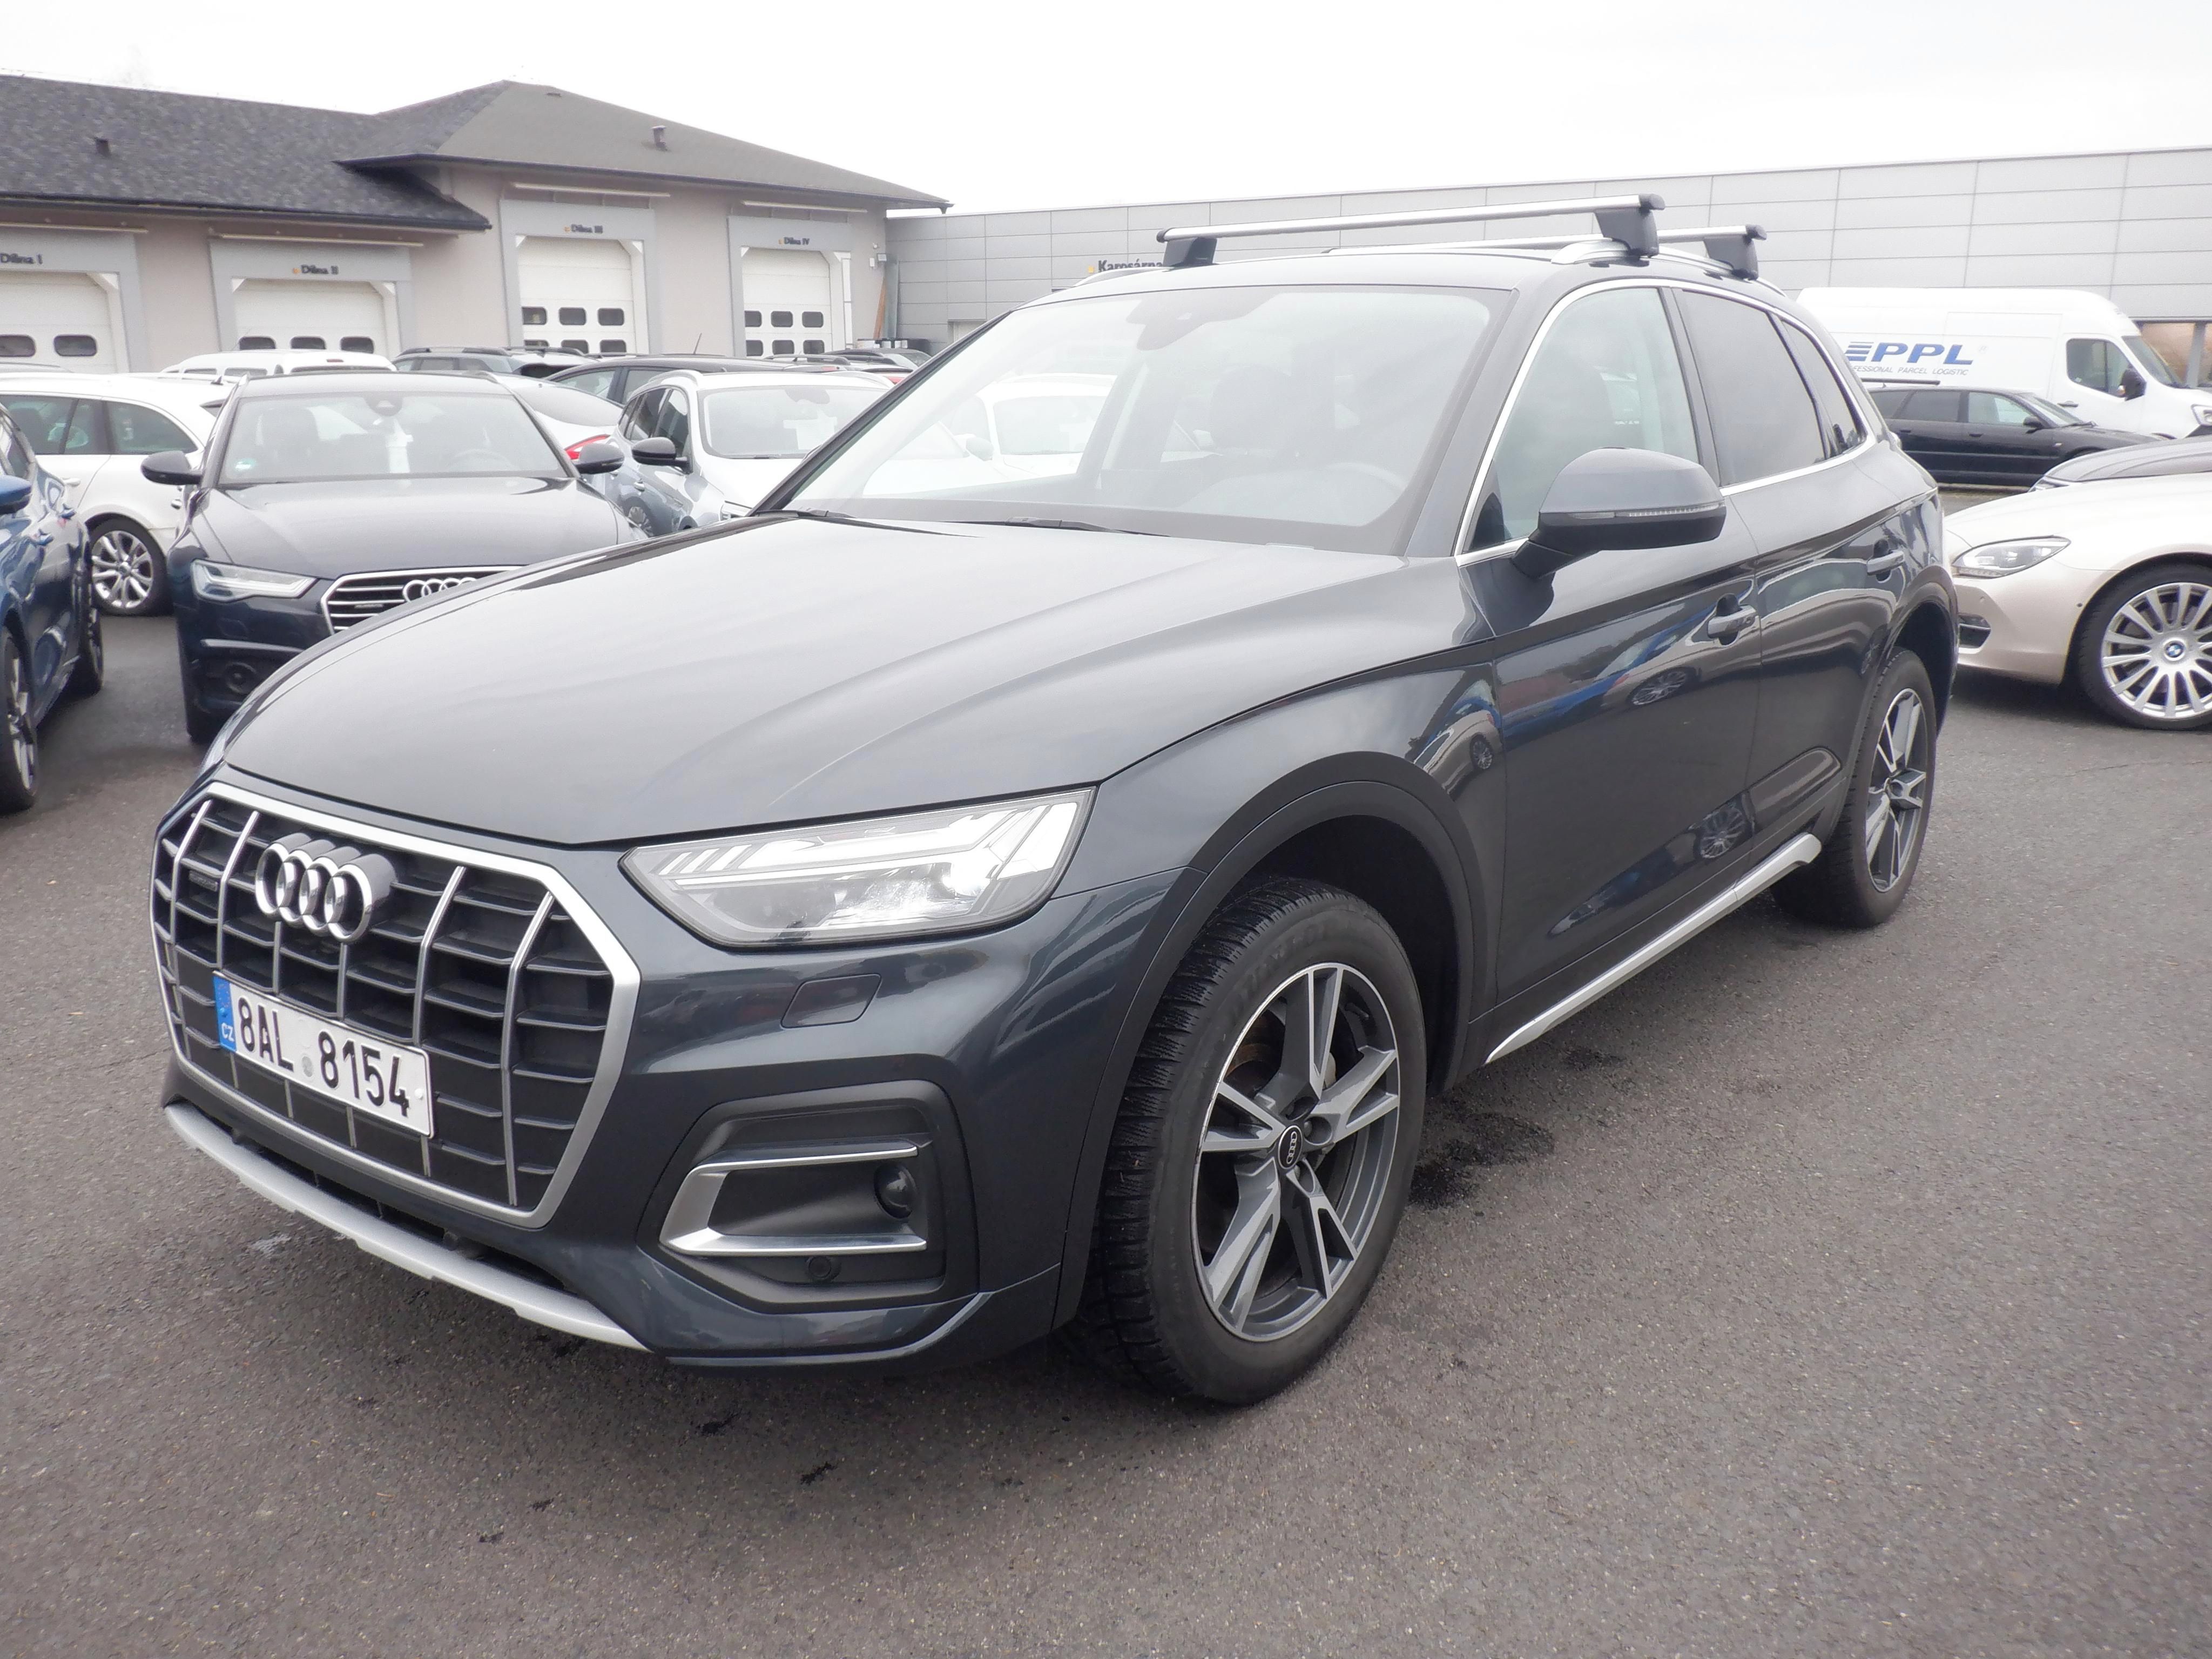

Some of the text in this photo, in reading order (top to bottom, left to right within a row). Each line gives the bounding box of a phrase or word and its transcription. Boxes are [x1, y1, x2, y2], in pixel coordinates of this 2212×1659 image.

[221, 1022, 234, 1042] CZ
[238, 997, 410, 1117] 8AL 8154
